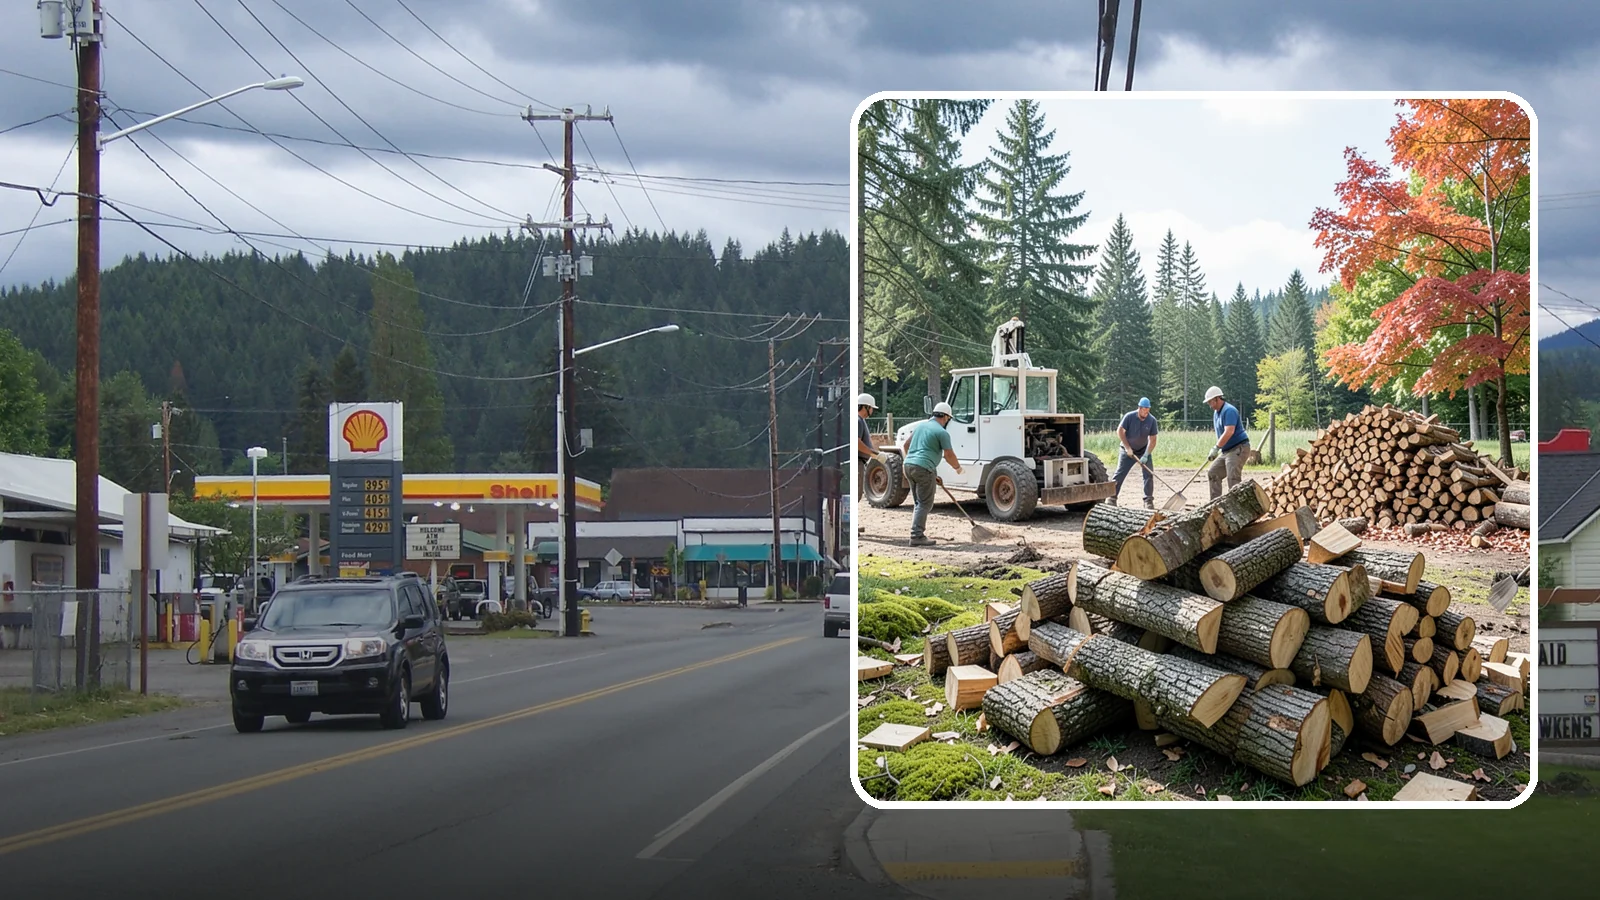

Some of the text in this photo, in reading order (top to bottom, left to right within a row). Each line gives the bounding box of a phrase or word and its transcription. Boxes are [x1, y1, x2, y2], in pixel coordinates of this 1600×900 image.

[366, 480, 383, 490] 395
[490, 484, 547, 499] Shell
[366, 494, 383, 504] 405
[366, 508, 383, 518] 415
[366, 522, 383, 532] 429
[1538, 642, 1567, 666] AID
